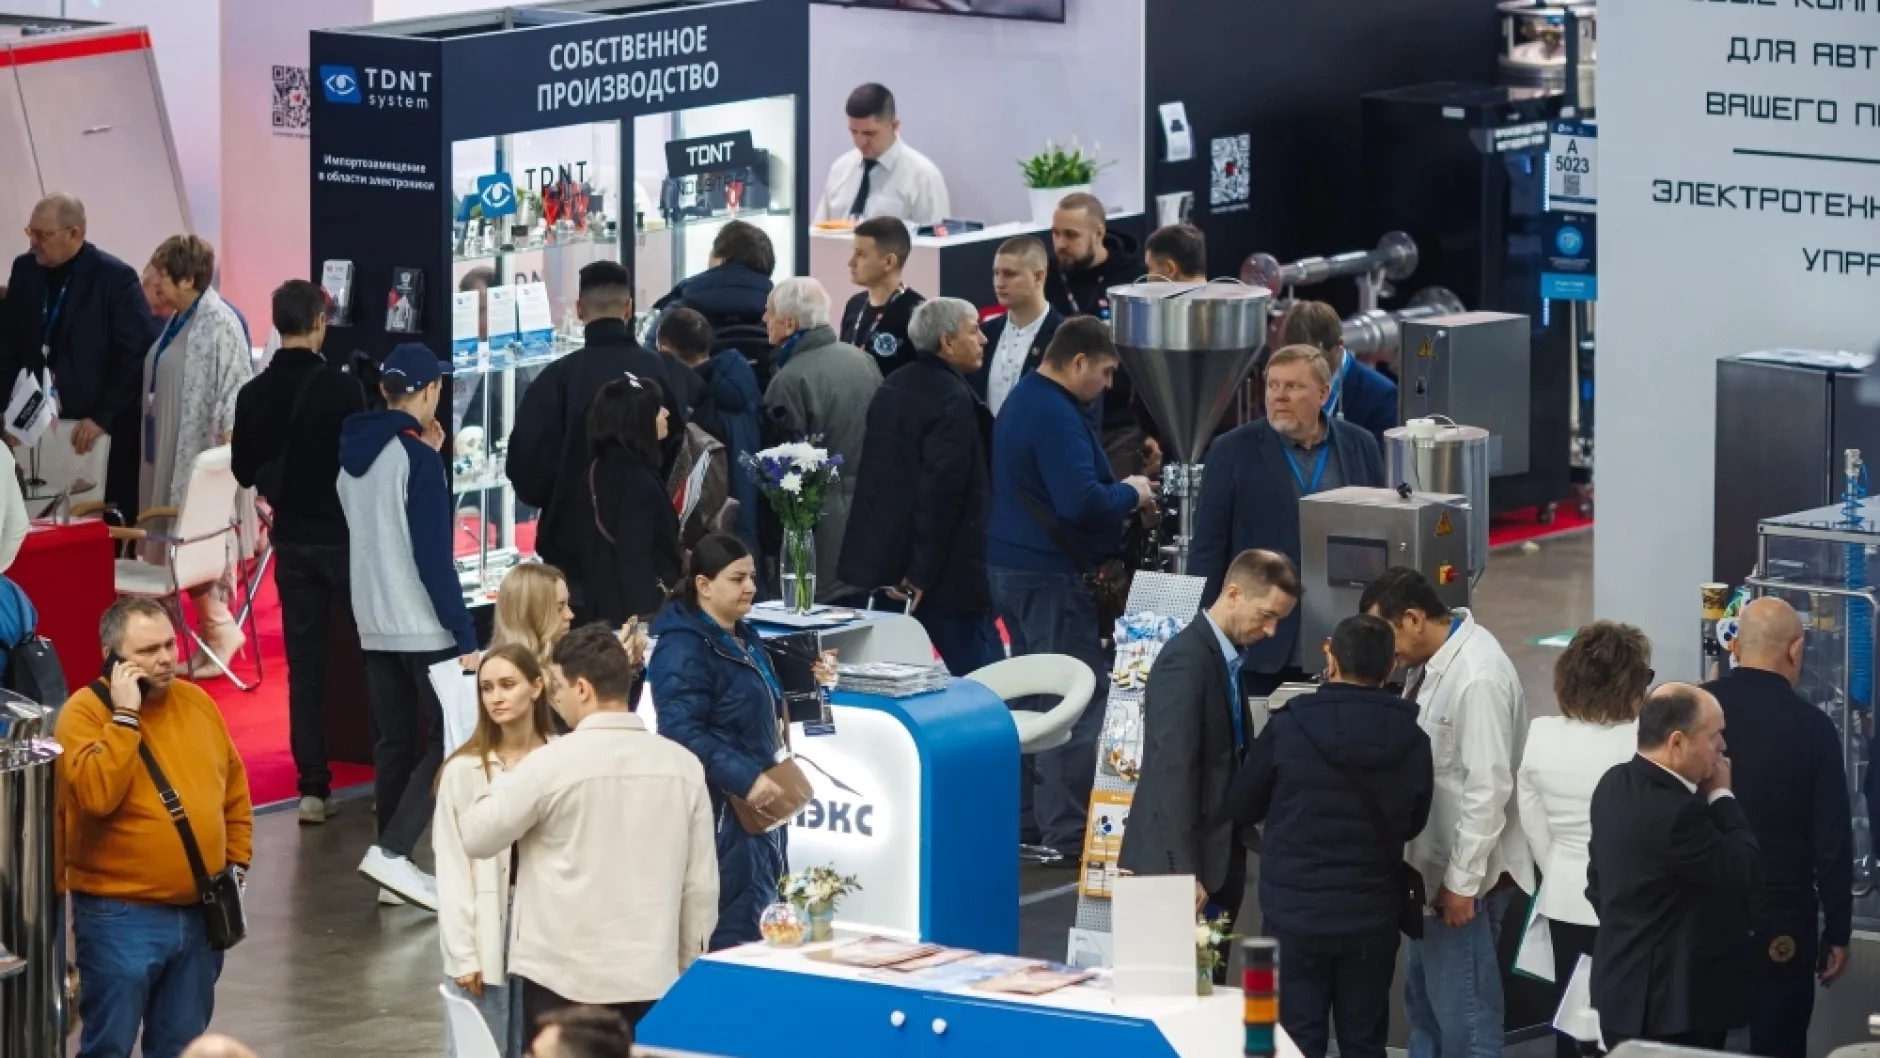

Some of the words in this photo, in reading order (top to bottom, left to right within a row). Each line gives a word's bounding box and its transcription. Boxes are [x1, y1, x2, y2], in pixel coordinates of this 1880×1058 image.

[550, 24, 708, 72] СОБСТВЕННОЕ
[1727, 36, 1796, 65] ДЛЯ
[1813, 42, 1879, 70] АВТ
[364, 67, 433, 93] TDNT
[537, 61, 719, 112] ПРОИЗВОДСТВО
[368, 93, 430, 110] system
[1706, 91, 1838, 125] ВАШЕГО
[1855, 102, 1880, 129] П
[323, 153, 426, 174] Импортозамещение
[685, 139, 736, 168] TDNT
[1555, 155, 1590, 174] 5023
[318, 171, 324, 181] в
[326, 170, 368, 185] области
[369, 175, 435, 191] электроники
[524, 160, 588, 194] TDNT
